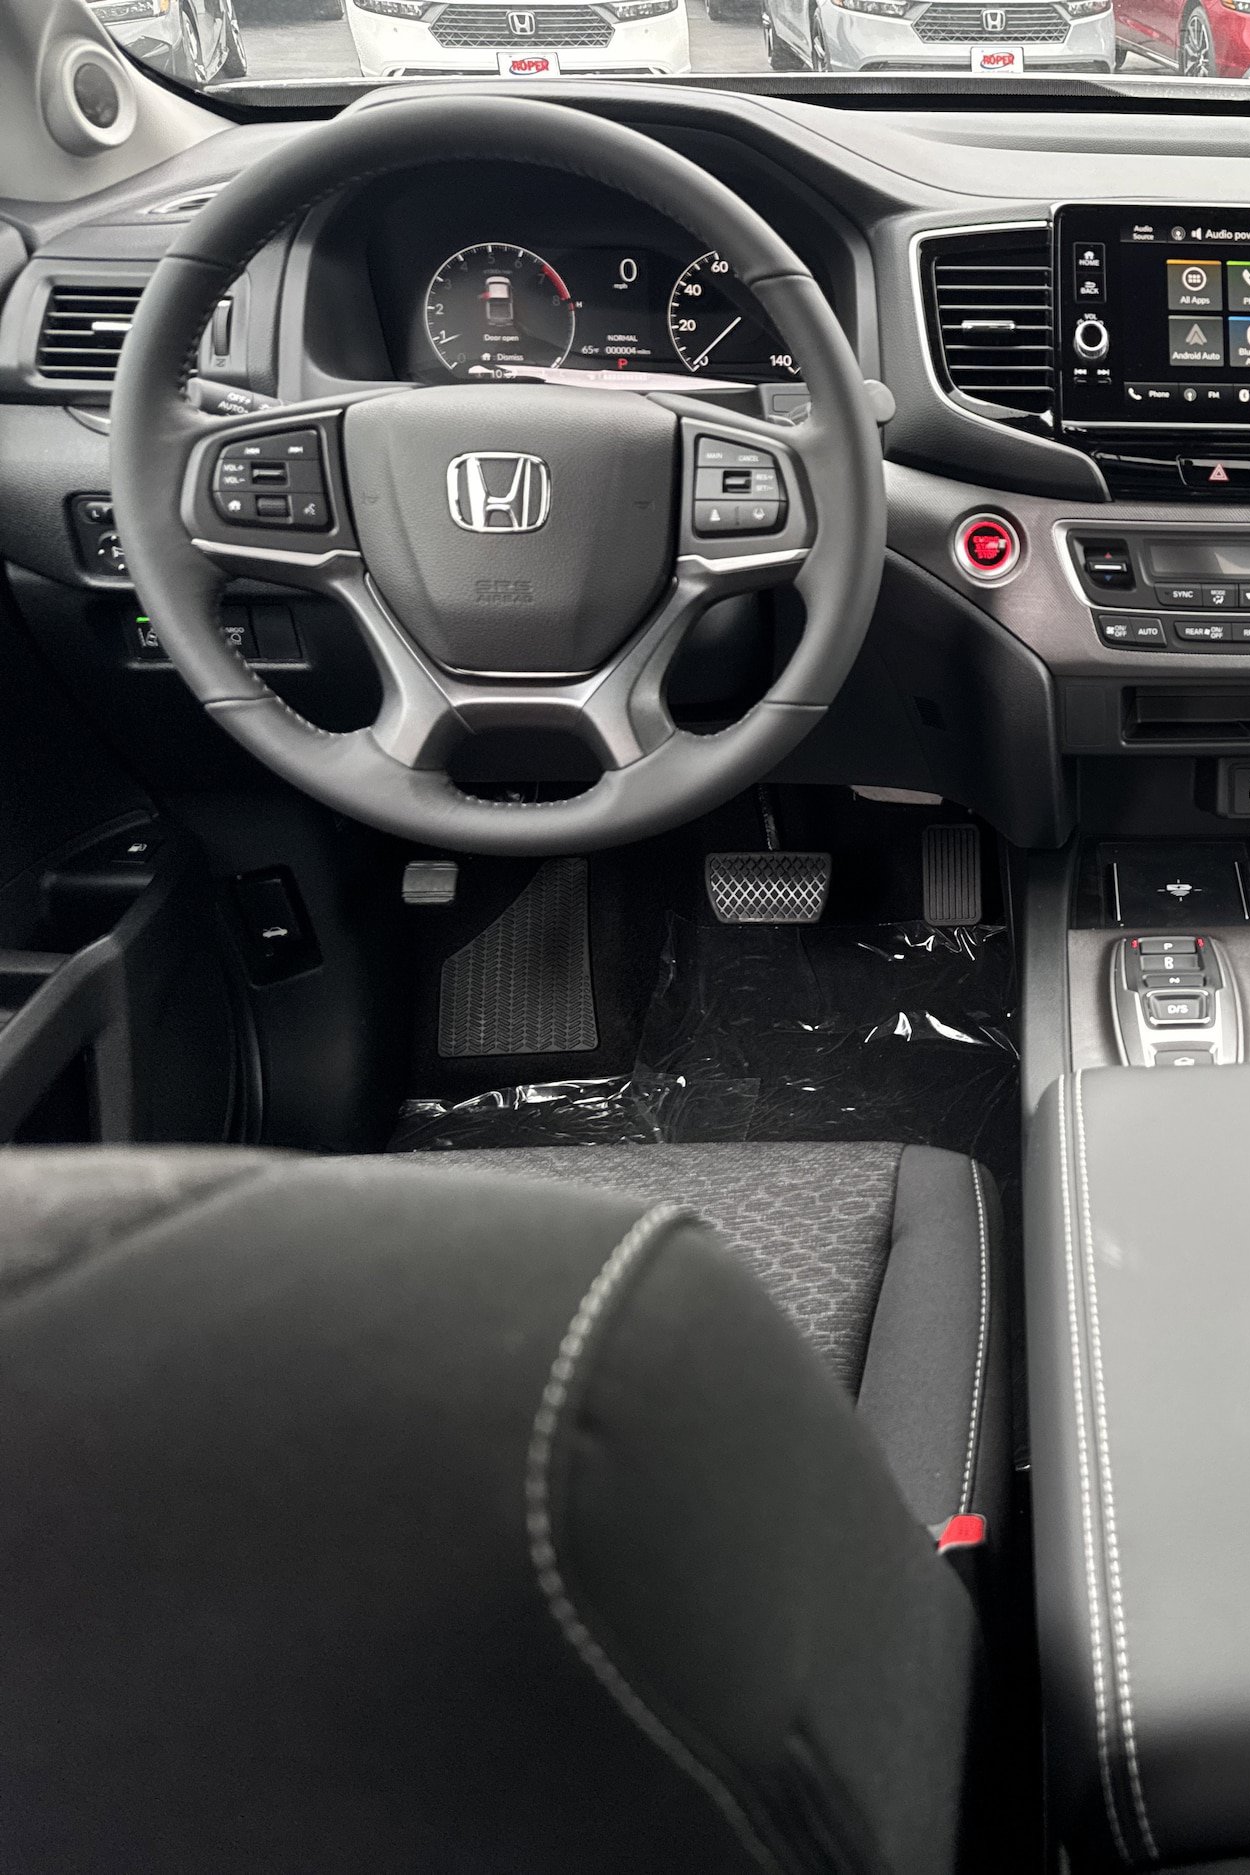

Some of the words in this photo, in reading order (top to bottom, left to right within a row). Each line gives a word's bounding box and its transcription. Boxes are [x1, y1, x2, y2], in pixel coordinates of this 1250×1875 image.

[1205, 230, 1232, 239] Audio
[619, 258, 637, 283] 0
[710, 260, 729, 273] 60
[684, 284, 702, 296] 40
[1179, 296, 1190, 304] All
[1191, 296, 1210, 306] Apps
[435, 304, 444, 314] 2
[679, 320, 696, 332] 20
[607, 334, 638, 342] NORMAL
[769, 355, 792, 367] 140
[1172, 352, 1202, 360] Android
[1202, 352, 1220, 361] Auto
[617, 358, 628, 369] P
[1149, 390, 1170, 398] Phone
[218, 401, 245, 414] AUTO
[1138, 628, 1158, 636] AUTO
[1185, 628, 1203, 636] REAR
[1164, 942, 1173, 950] P
[1168, 1004, 1188, 1014] D/S
